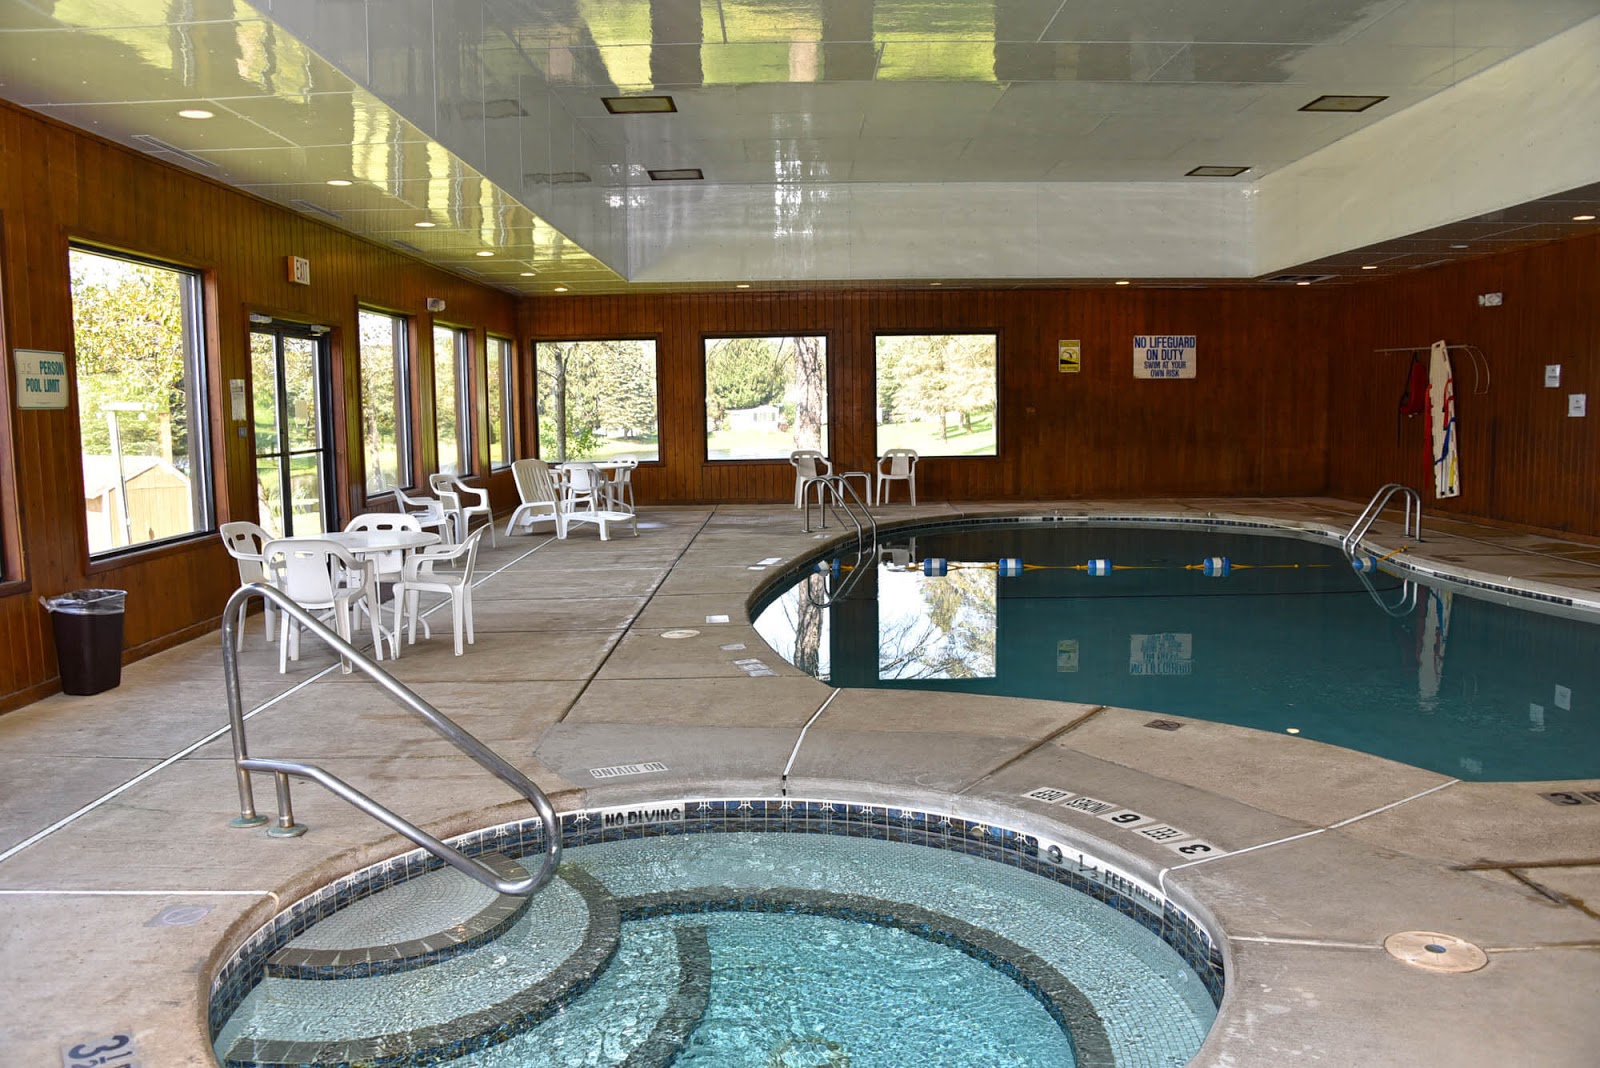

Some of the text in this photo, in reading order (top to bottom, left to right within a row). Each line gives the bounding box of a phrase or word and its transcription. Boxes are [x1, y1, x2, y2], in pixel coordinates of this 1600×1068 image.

[1135, 336, 1195, 348] NO LIFEGUARD
[1146, 349, 1184, 361] ON DUTY
[39, 360, 65, 376] PERSON
[1144, 361, 1186, 369] SWIM AT YOUR
[1150, 369, 1179, 378] OWN RISK
[25, 378, 60, 392] POOL LIMIT
[591, 762, 665, 777] NO DIVING
[1030, 789, 1068, 801] DEEP
[1550, 792, 1582, 806] 3
[605, 807, 681, 827] NO DIVING
[1141, 826, 1184, 840] FEET
[1179, 843, 1212, 855] 3
[1105, 869, 1134, 897] FEET
[68, 1034, 130, 1060] 3
